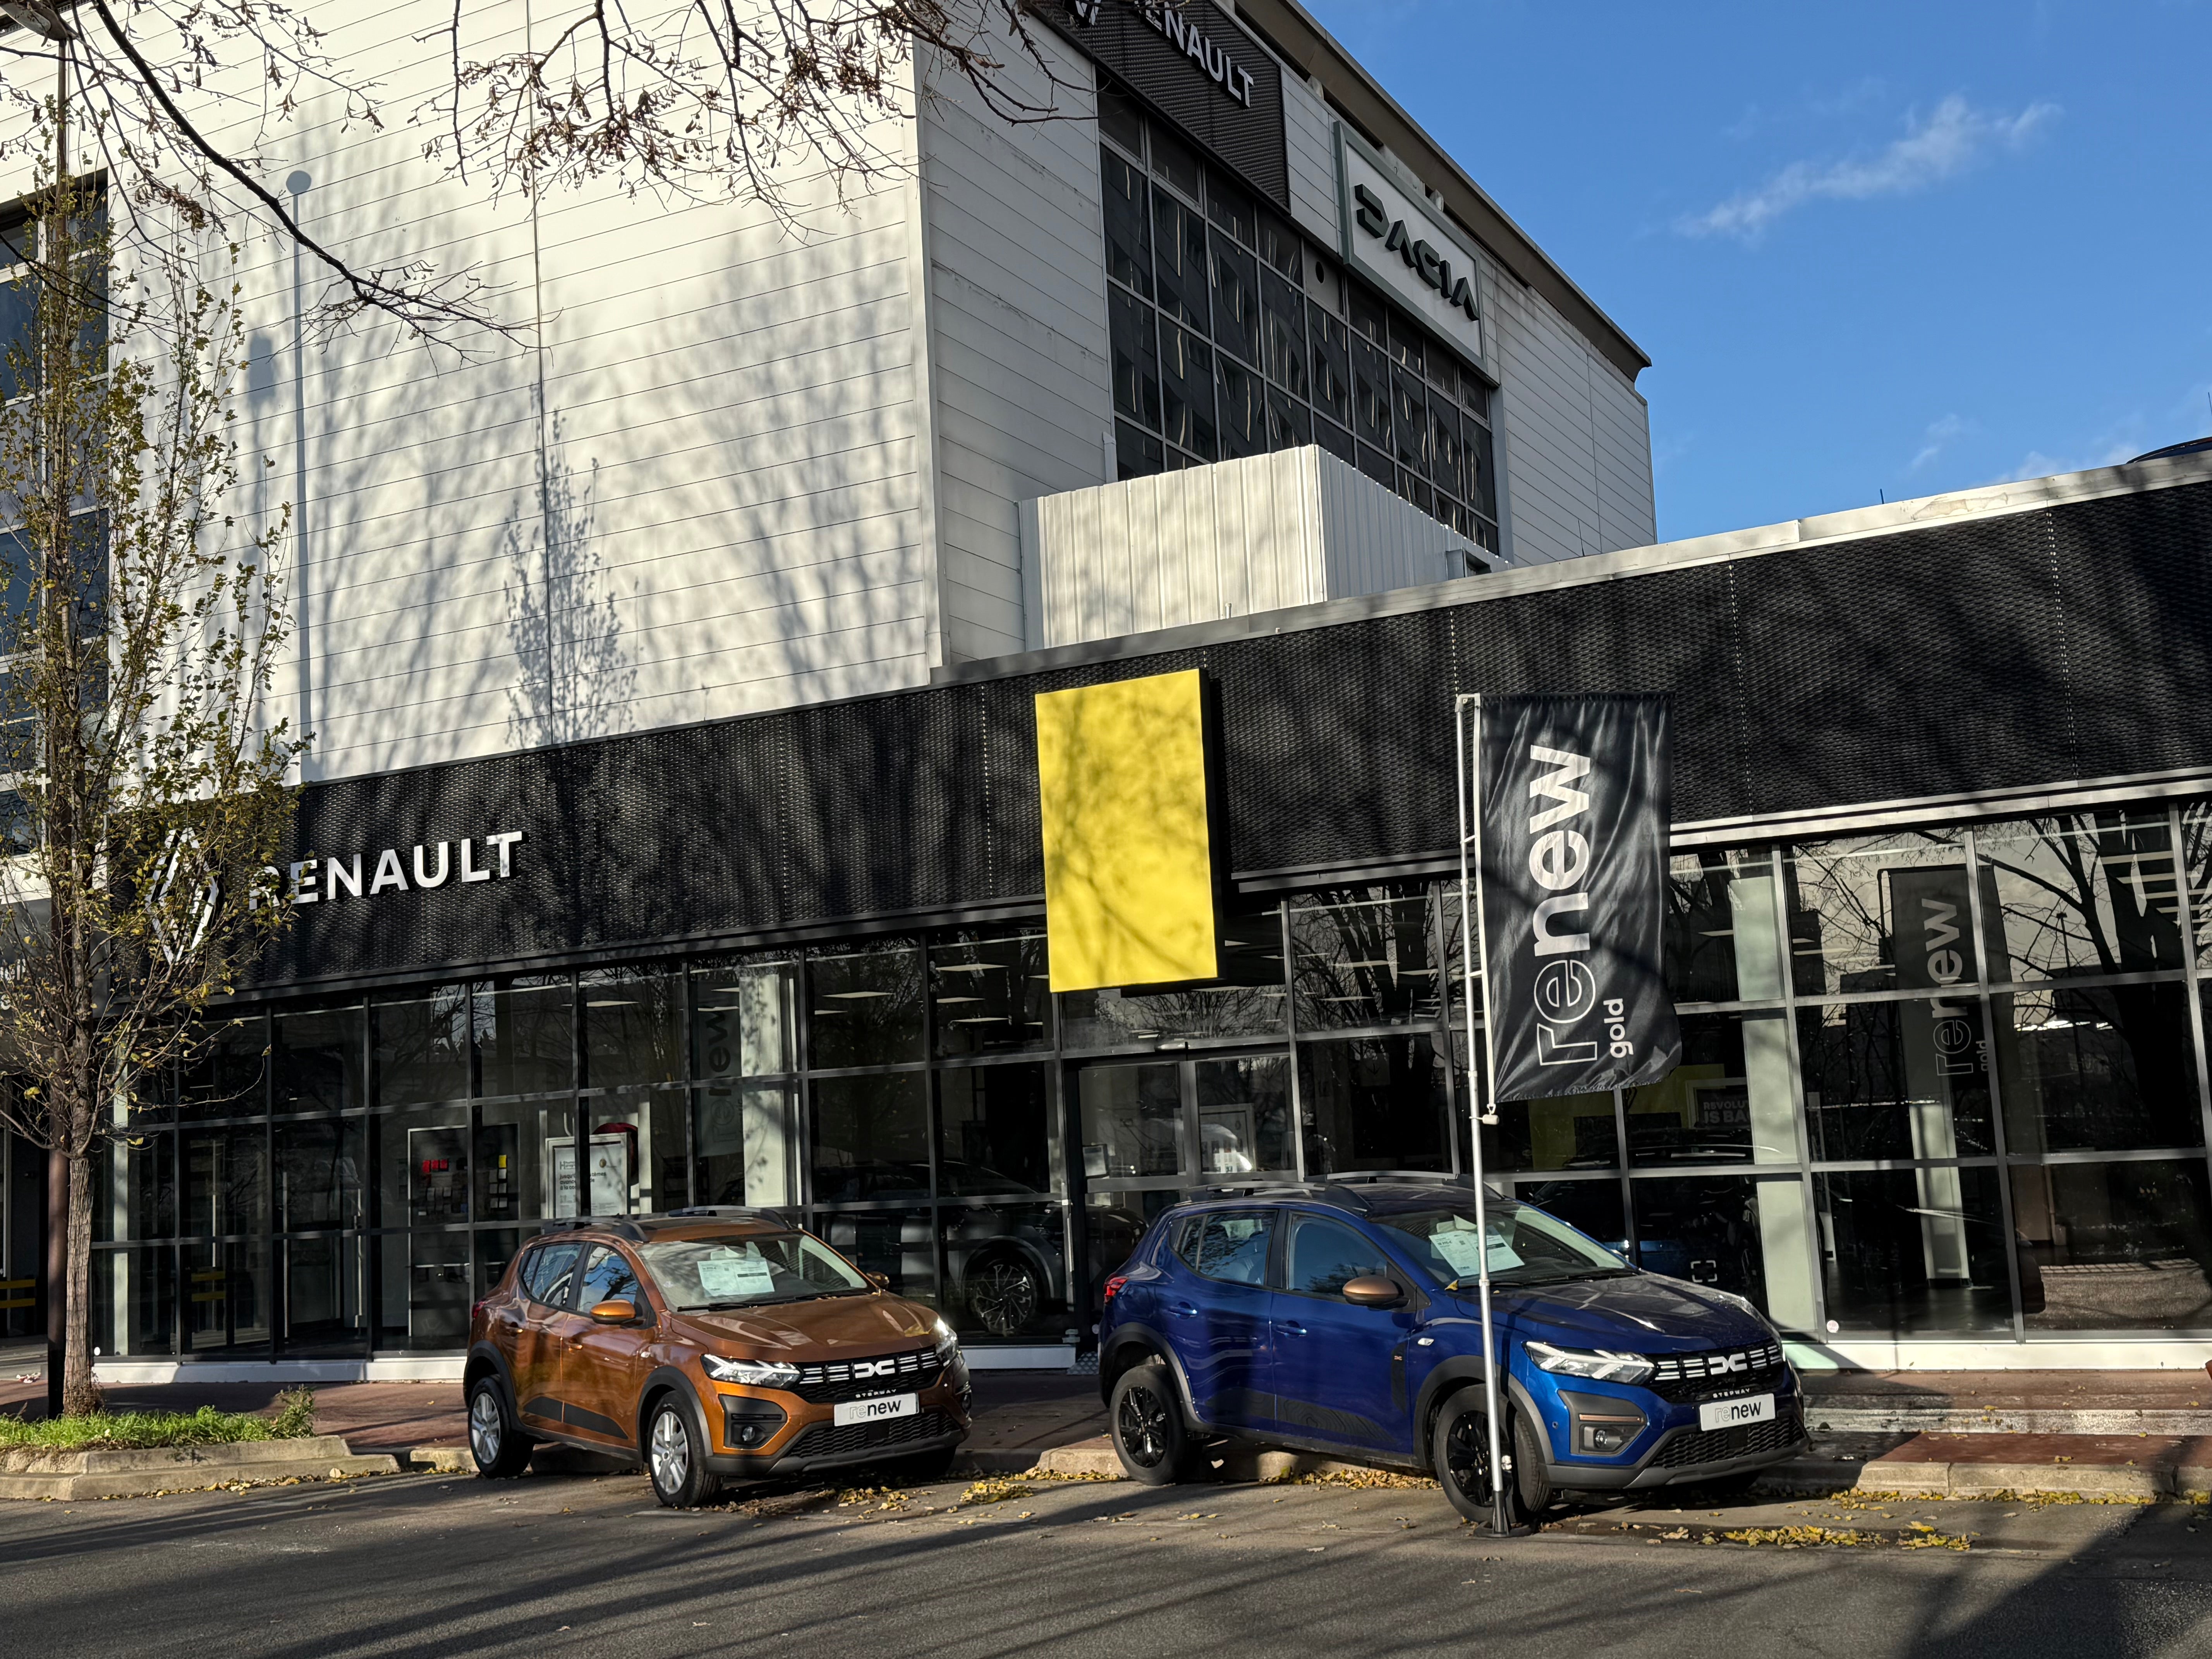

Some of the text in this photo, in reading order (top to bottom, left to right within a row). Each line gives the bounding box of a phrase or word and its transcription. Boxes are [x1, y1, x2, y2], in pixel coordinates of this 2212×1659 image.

[1134, 0, 1254, 108] ENAULT
[1355, 184, 1479, 321] DACIA
[249, 831, 522, 910] RENAULT
[1529, 744, 1598, 1066] renew
[1603, 998, 1634, 1058] gold
[1704, 1109, 1749, 1124] IS BA
[850, 1400, 901, 1419] renew
[855, 1389, 896, 1398] STEPWAY
[1713, 1388, 1750, 1398] STEPWAY
[1715, 1401, 1761, 1423] renew
